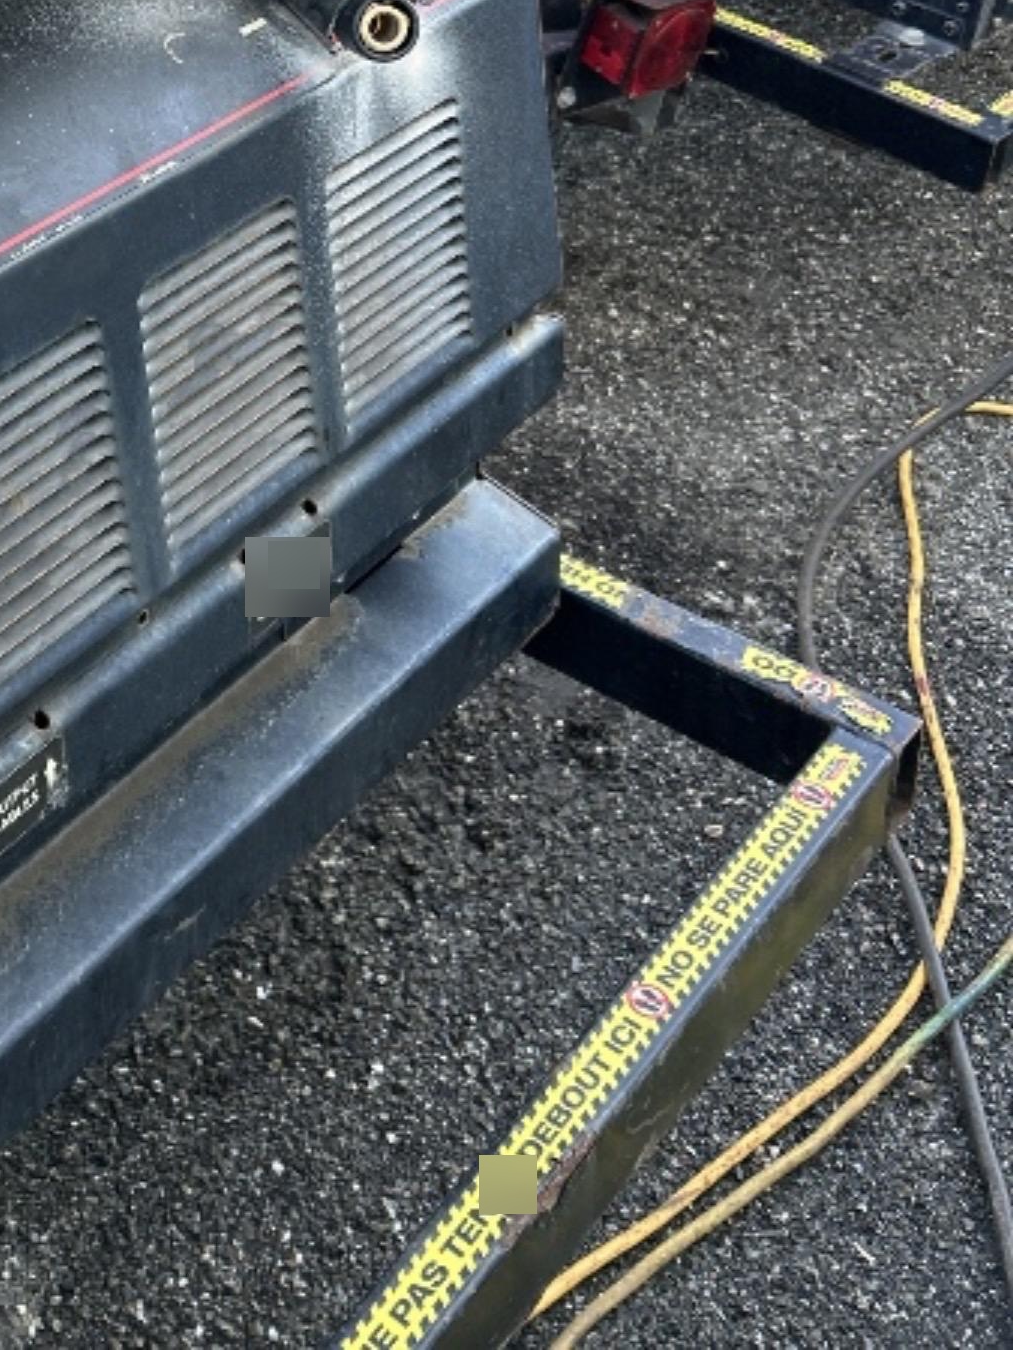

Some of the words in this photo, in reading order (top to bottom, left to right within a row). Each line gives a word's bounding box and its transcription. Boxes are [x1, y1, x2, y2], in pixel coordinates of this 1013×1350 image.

[656, 950, 694, 988] NO
[688, 916, 724, 950] SE
[711, 857, 768, 918] PARE
[389, 1261, 449, 1329] PAS
[440, 1207, 490, 1257] TE
[605, 1017, 642, 1054] ICI
